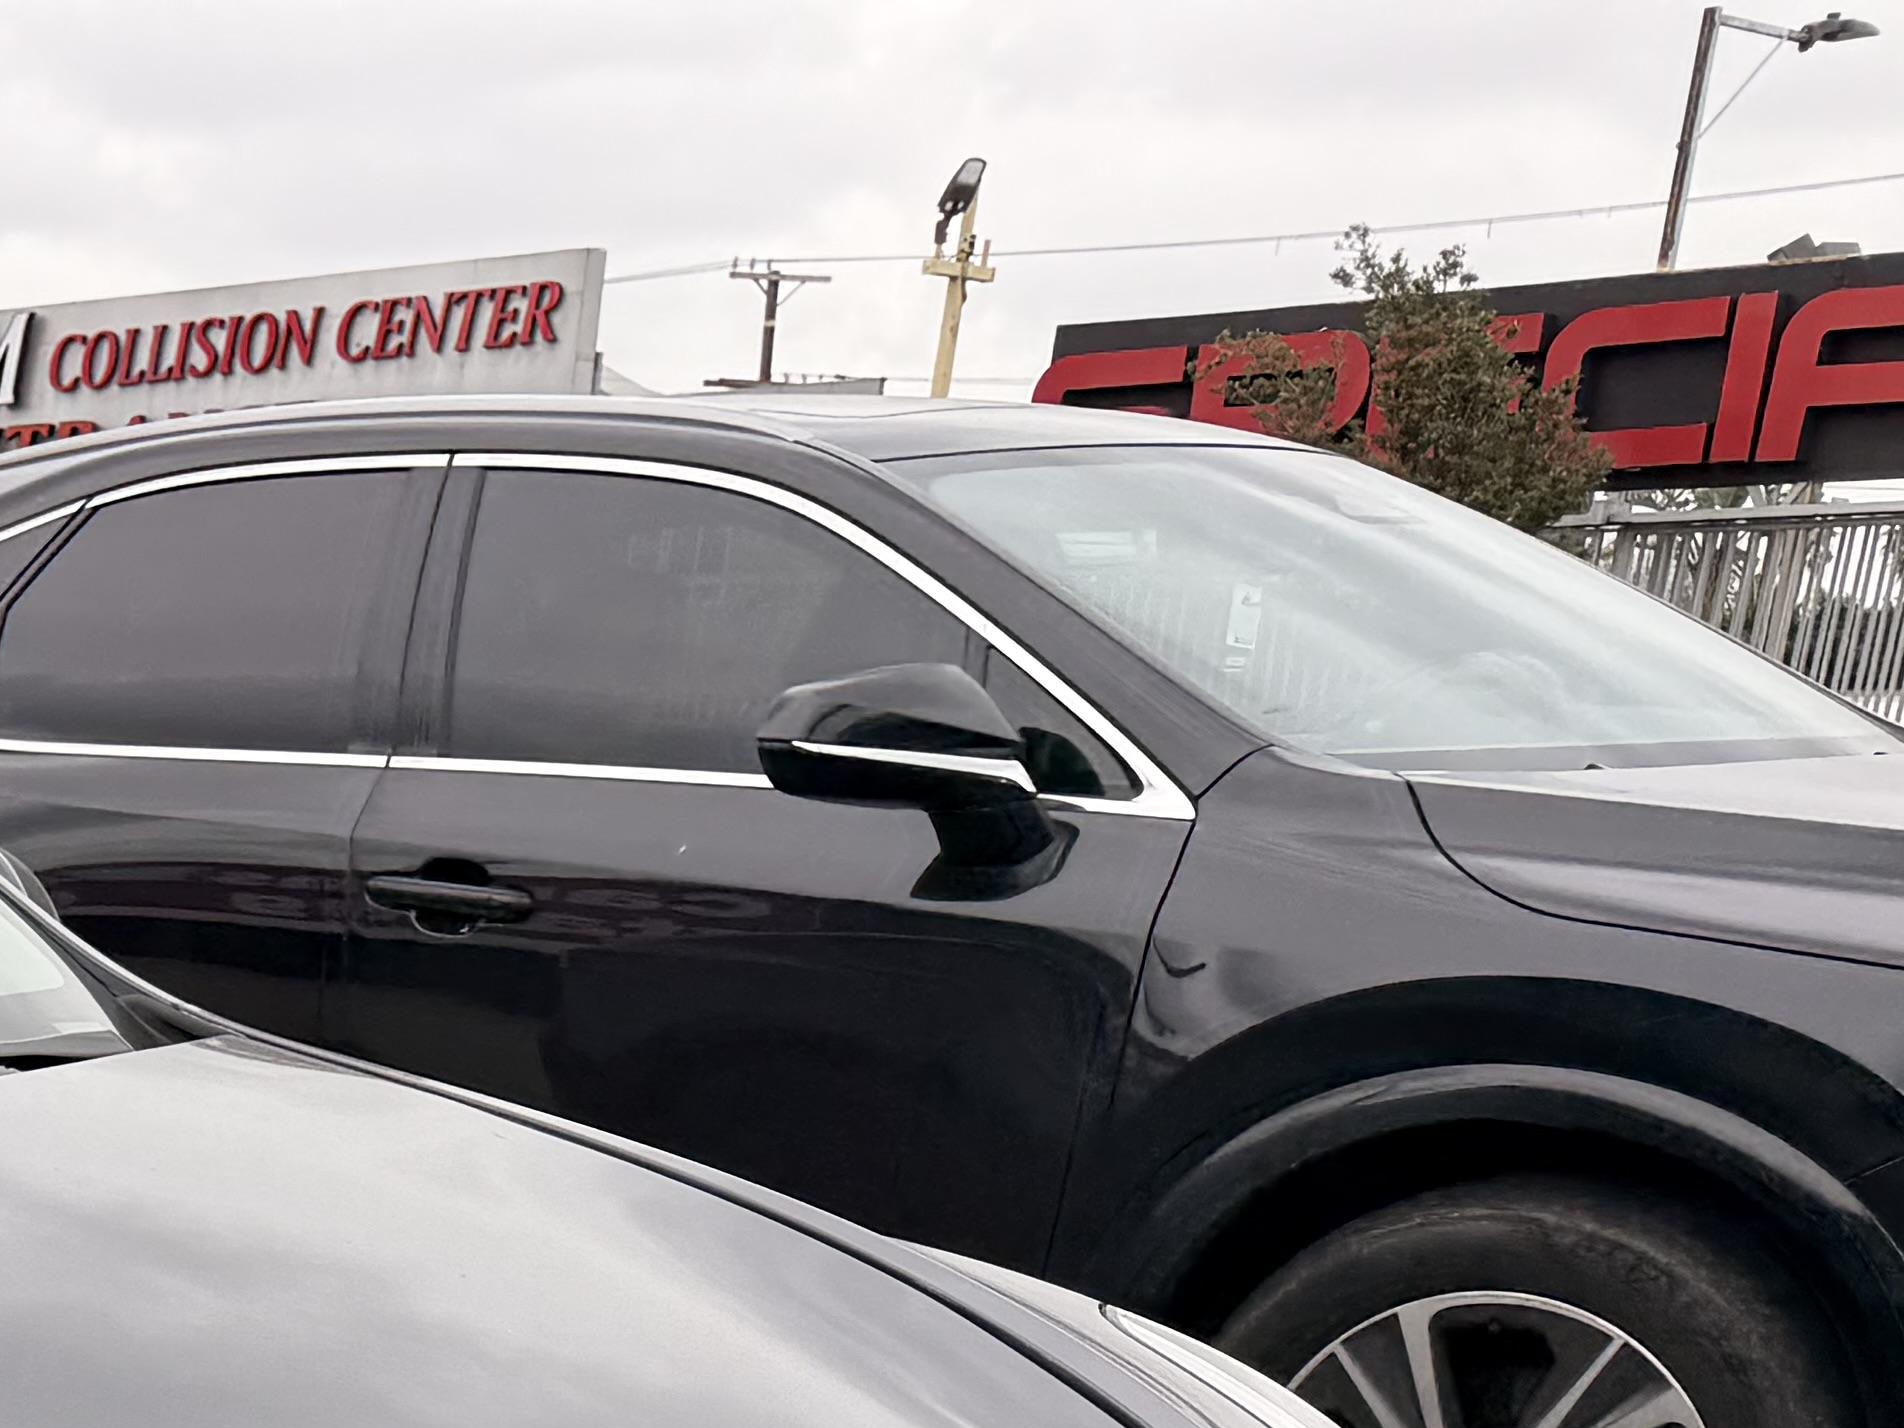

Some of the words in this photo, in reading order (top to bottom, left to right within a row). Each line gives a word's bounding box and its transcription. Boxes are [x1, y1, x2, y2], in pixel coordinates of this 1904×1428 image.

[49, 306, 325, 393] COLLISION
[335, 280, 563, 362] CENTER
[1031, 284, 1904, 471] SPCIA
